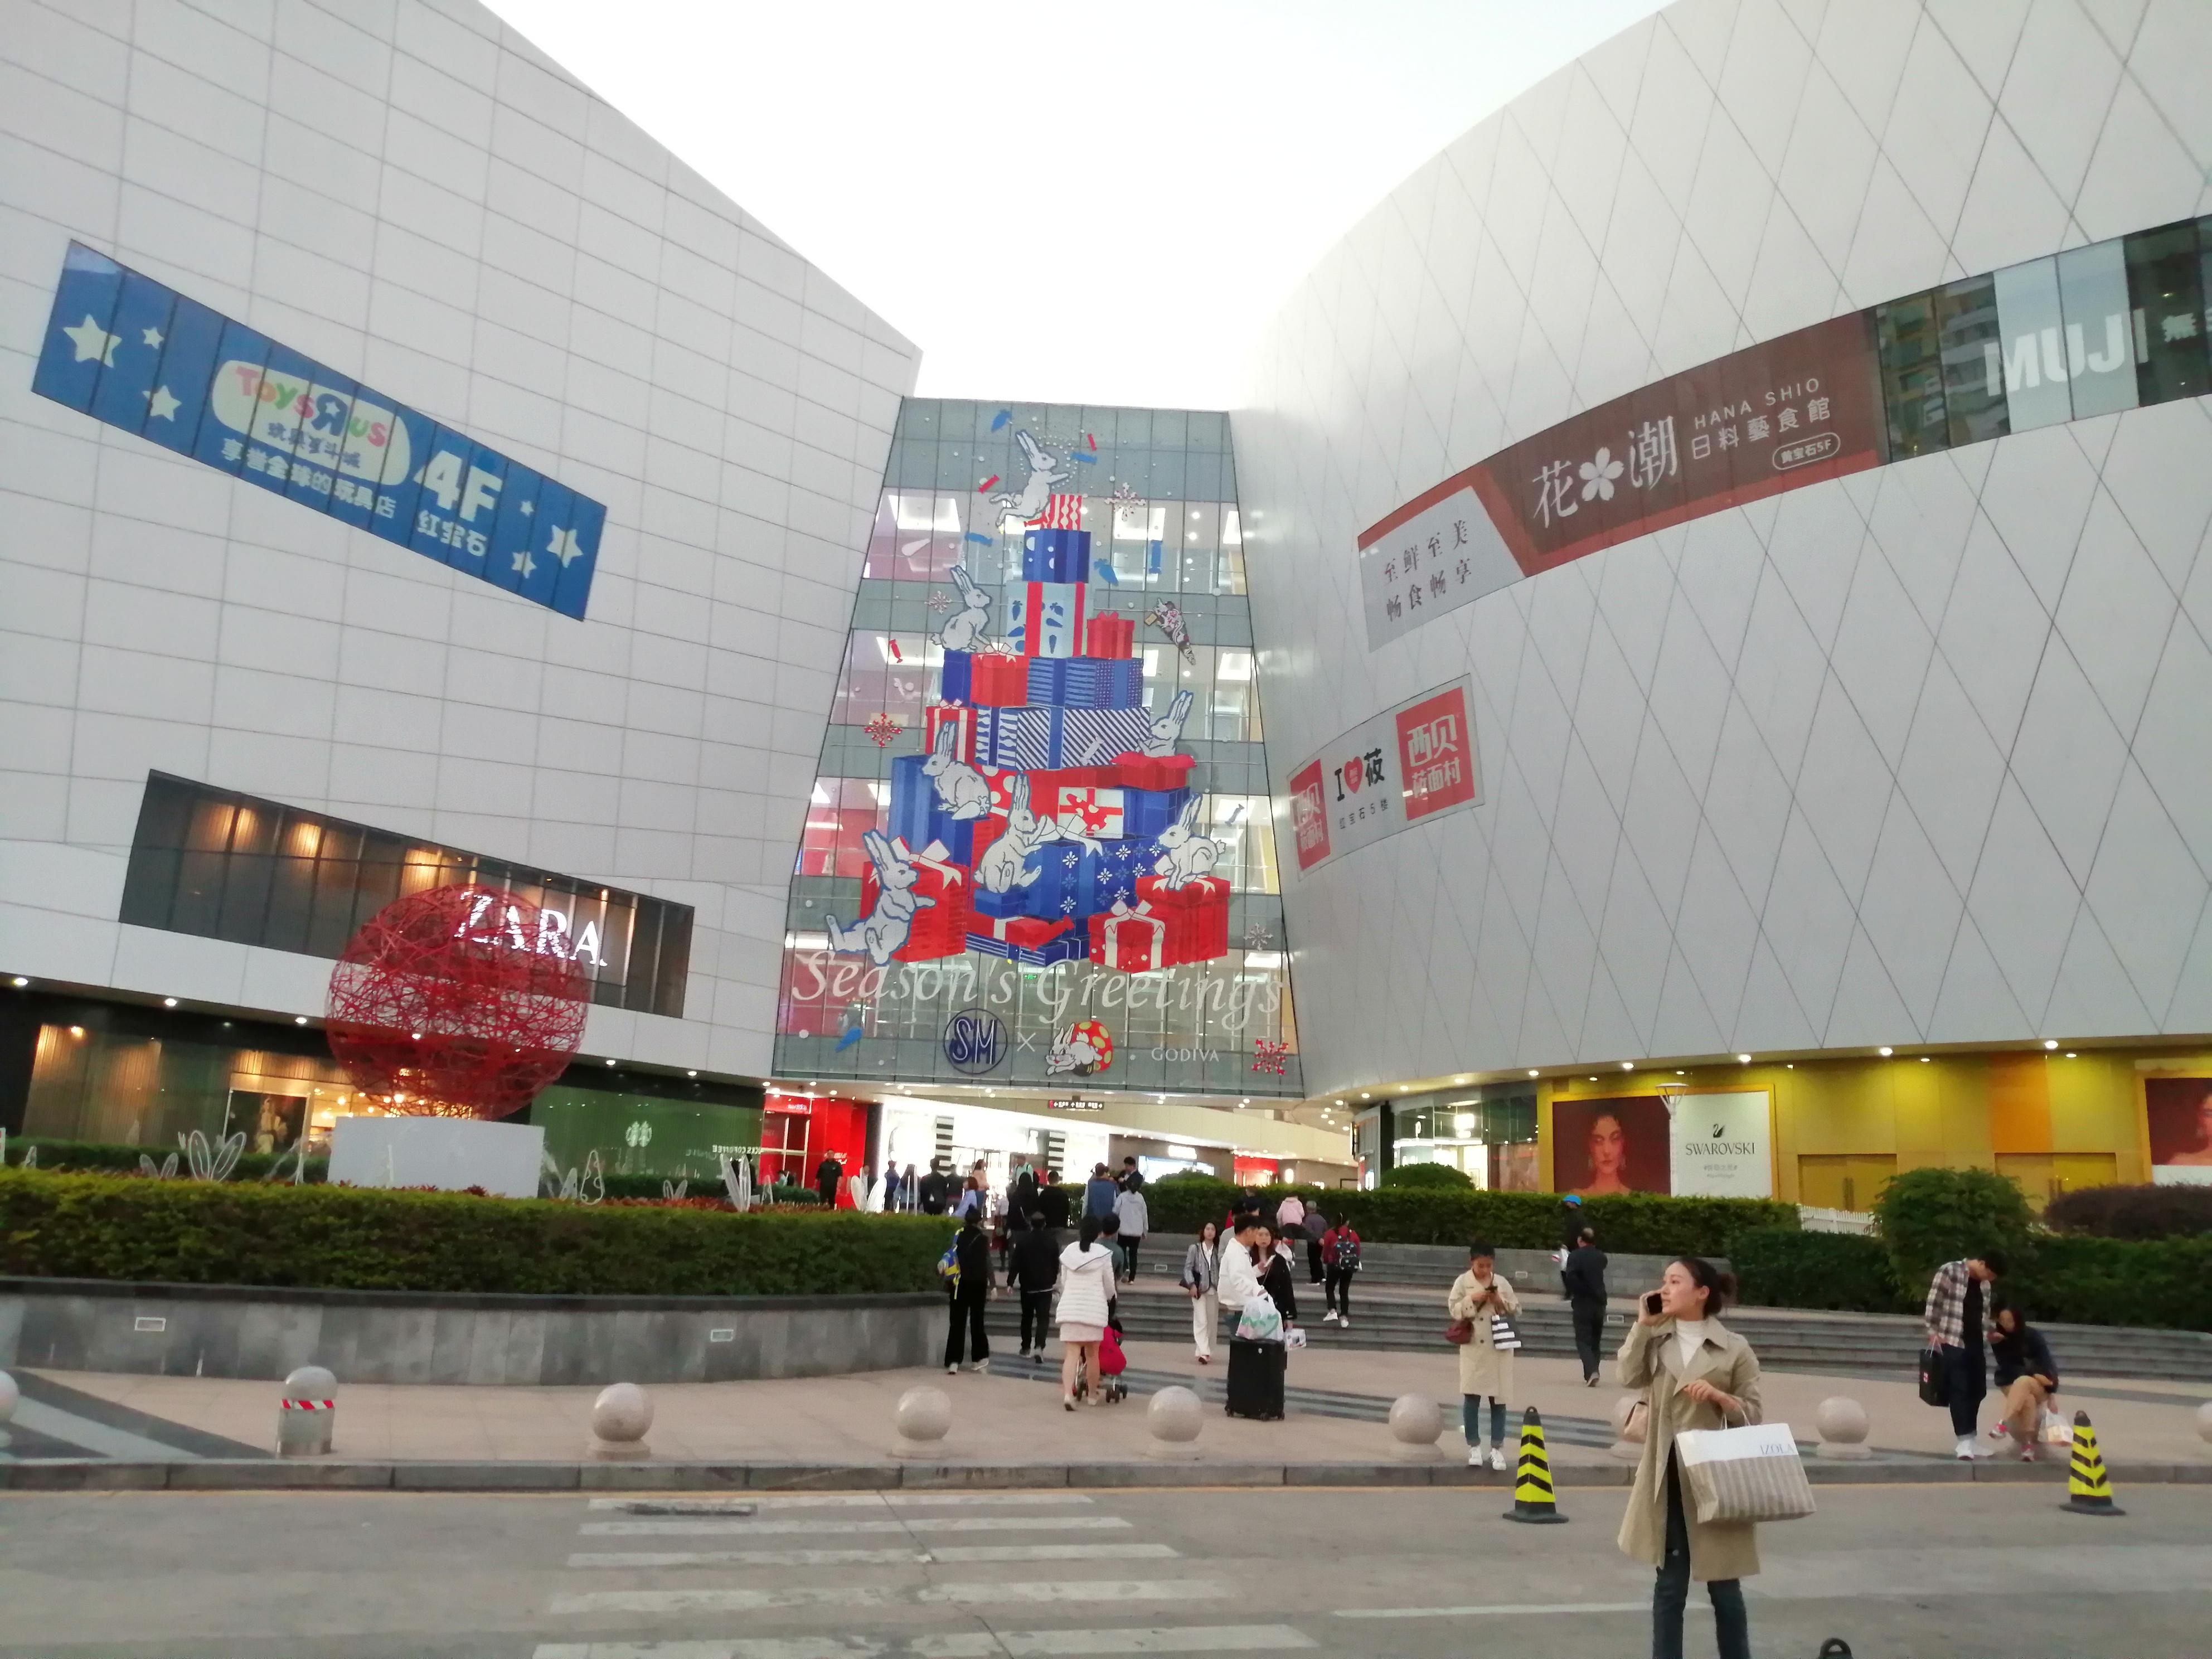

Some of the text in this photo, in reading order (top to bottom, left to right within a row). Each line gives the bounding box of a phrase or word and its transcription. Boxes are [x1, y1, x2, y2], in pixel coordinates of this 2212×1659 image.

[1983, 305, 2149, 397] MUJI
[1694, 378, 1819, 429] HANA SHIO
[413, 450, 503, 522] 4F
[418, 510, 488, 556] 红宝石
[1407, 714, 1458, 767] 西贝
[454, 891, 608, 967] ZARA
[792, 949, 1283, 1031] Season's Greetings
[949, 1016, 998, 1065] SM
[1151, 1047, 1220, 1062] GODIVA
[1686, 1142, 1755, 1155] SWAROVSKI
